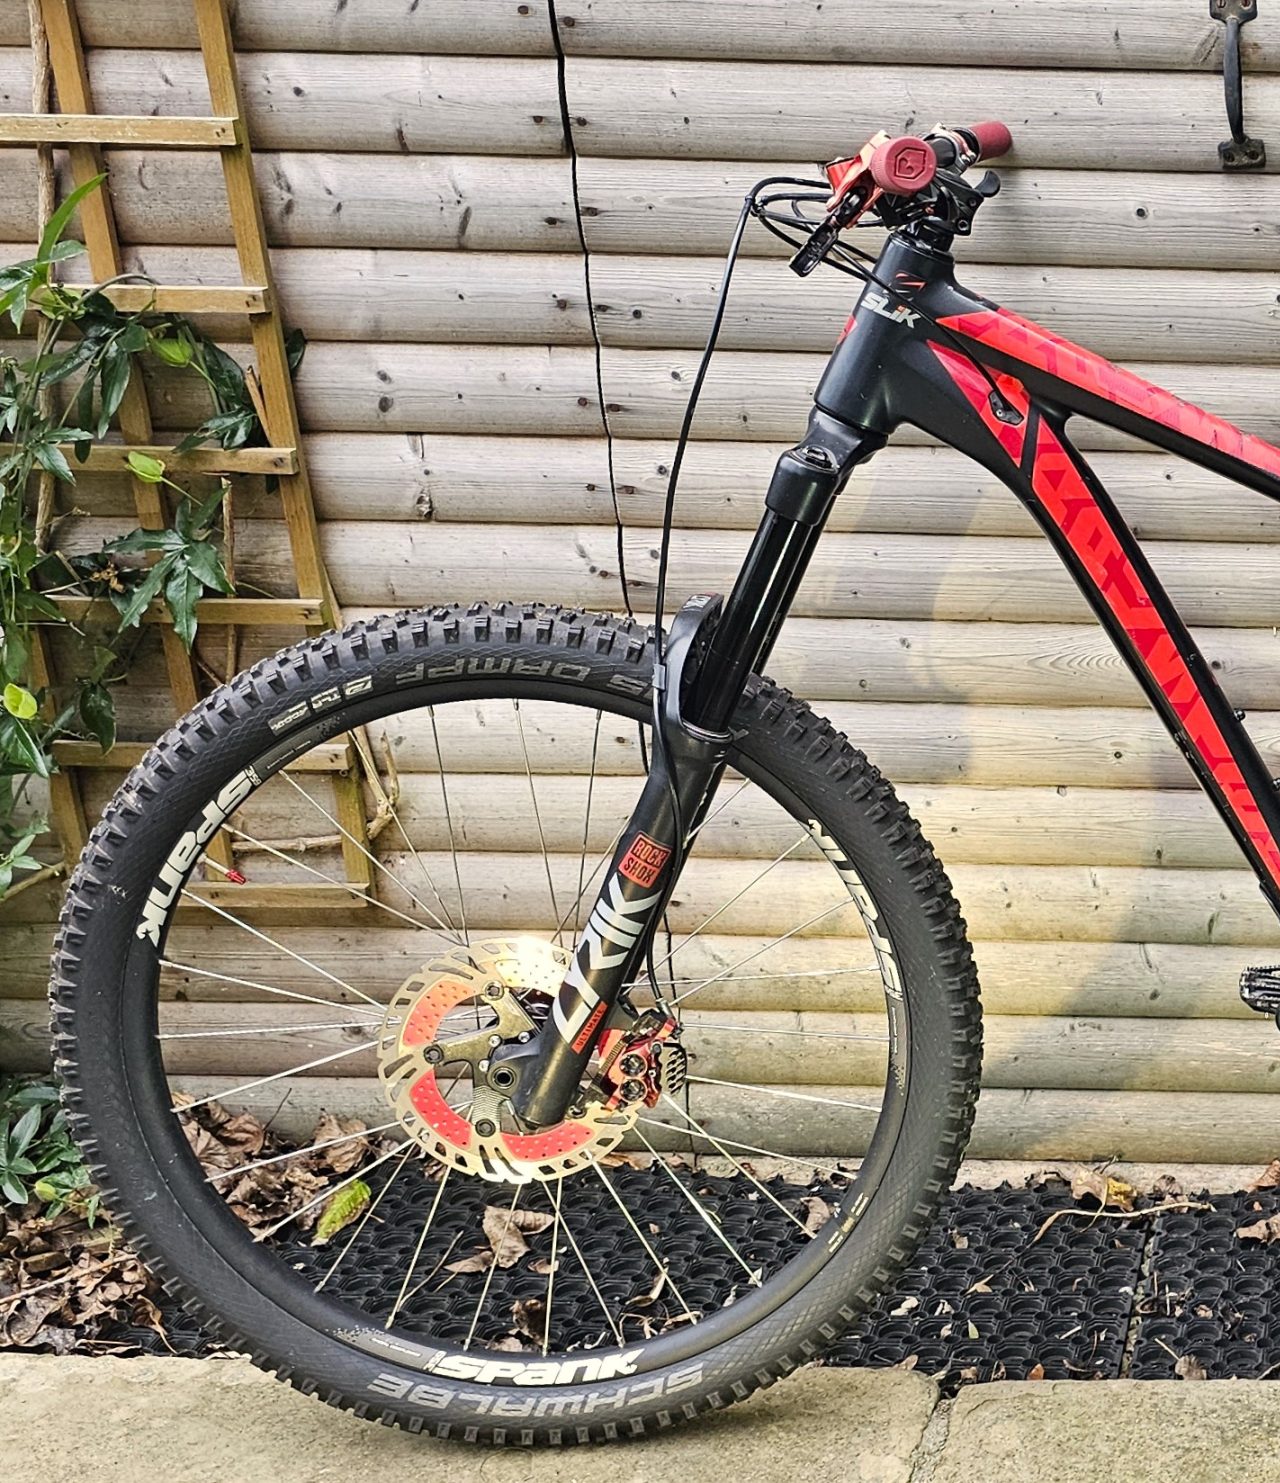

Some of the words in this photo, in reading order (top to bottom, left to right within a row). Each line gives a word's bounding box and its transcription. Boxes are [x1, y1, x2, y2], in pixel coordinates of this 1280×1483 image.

[634, 838, 666, 866] ROCK
[624, 857, 655, 885] SHOX
[576, 1007, 604, 1047] ULTIMATE
[368, 1363, 702, 1417] SCHWALBE
